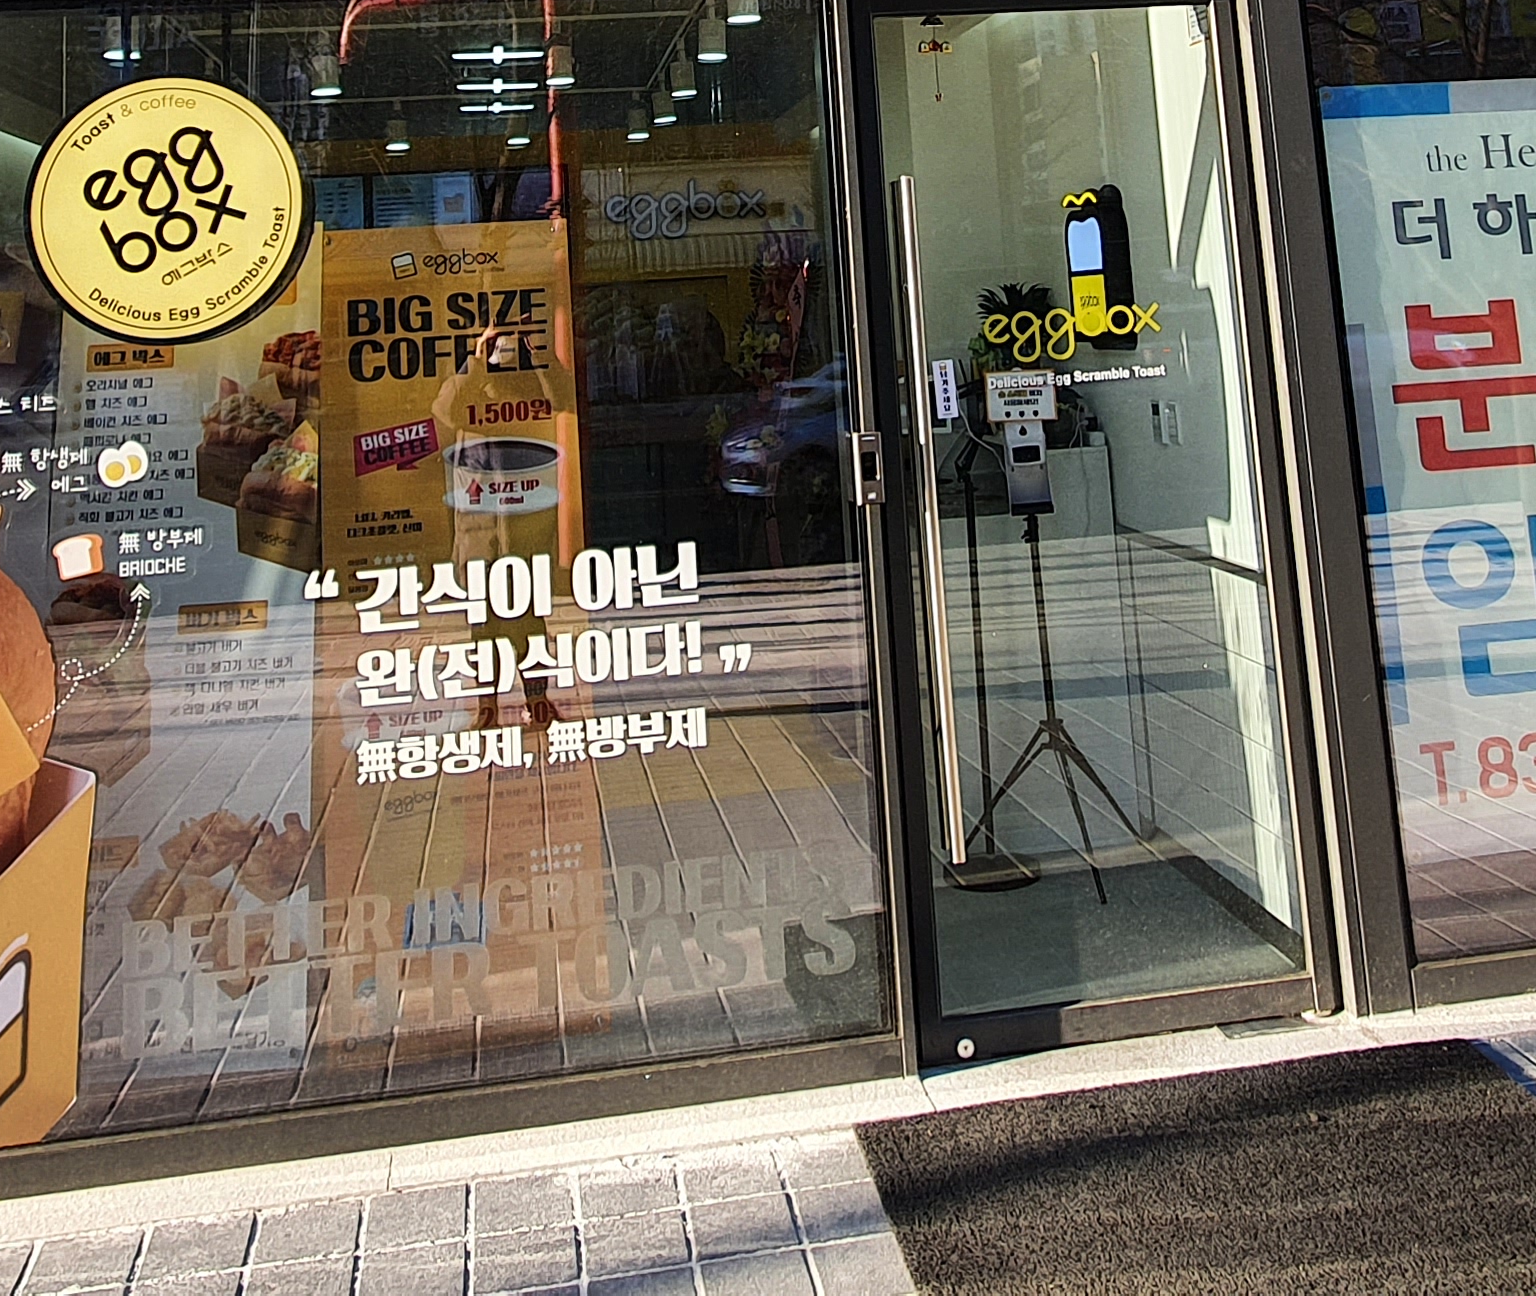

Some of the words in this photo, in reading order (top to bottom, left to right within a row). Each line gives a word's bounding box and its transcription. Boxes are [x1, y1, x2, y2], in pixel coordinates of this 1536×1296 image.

[70, 111, 116, 154] Toast
[120, 102, 134, 118] &
[138, 94, 198, 113] coffee
[83, 126, 224, 217] egg
[1426, 145, 1468, 172] the
[99, 183, 247, 273] box
[605, 180, 766, 240] eggbox
[1391, 197, 1452, 260] 더
[88, 286, 162, 323] Delicious
[168, 304, 201, 323] Egg
[204, 257, 269, 312] Scramble
[261, 205, 286, 251] Toast
[161, 241, 234, 287] 에그박스
[422, 247, 500, 277] eggbox
[347, 295, 433, 338] BIG
[446, 287, 548, 330] SIZE
[94, 350, 126, 366] 에그
[348, 329, 551, 383] COFFEE
[132, 377, 154, 390] 에그
[988, 374, 1045, 390] Delicious
[1047, 372, 1072, 387] Egg
[1073, 368, 1131, 385] Scramble
[1133, 364, 1166, 379] Toast
[20, 396, 57, 414] 치즈
[465, 398, 553, 428] 1,500원
[360, 433, 391, 452] BIG
[393, 425, 431, 448] SIZE
[363, 438, 432, 466] COFFEE
[1, 450, 24, 473] 無
[29, 445, 88, 473] 항생제
[51, 475, 89, 495] 에그
[487, 480, 519, 495] SIZE
[519, 478, 541, 493] UP
[118, 531, 141, 553] 無
[146, 527, 203, 552] 방부제
[355, 552, 552, 634] 간식이
[572, 542, 700, 611] 아닌
[355, 621, 704, 707] 완(전)식이다!
[389, 710, 422, 728] SIZE
[424, 709, 444, 724] UP
[547, 707, 708, 765] 無방부제
[122, 895, 393, 981] BETTER
[409, 838, 849, 950] INGREDIENTS
[518, 896, 858, 1007] TOASTS
